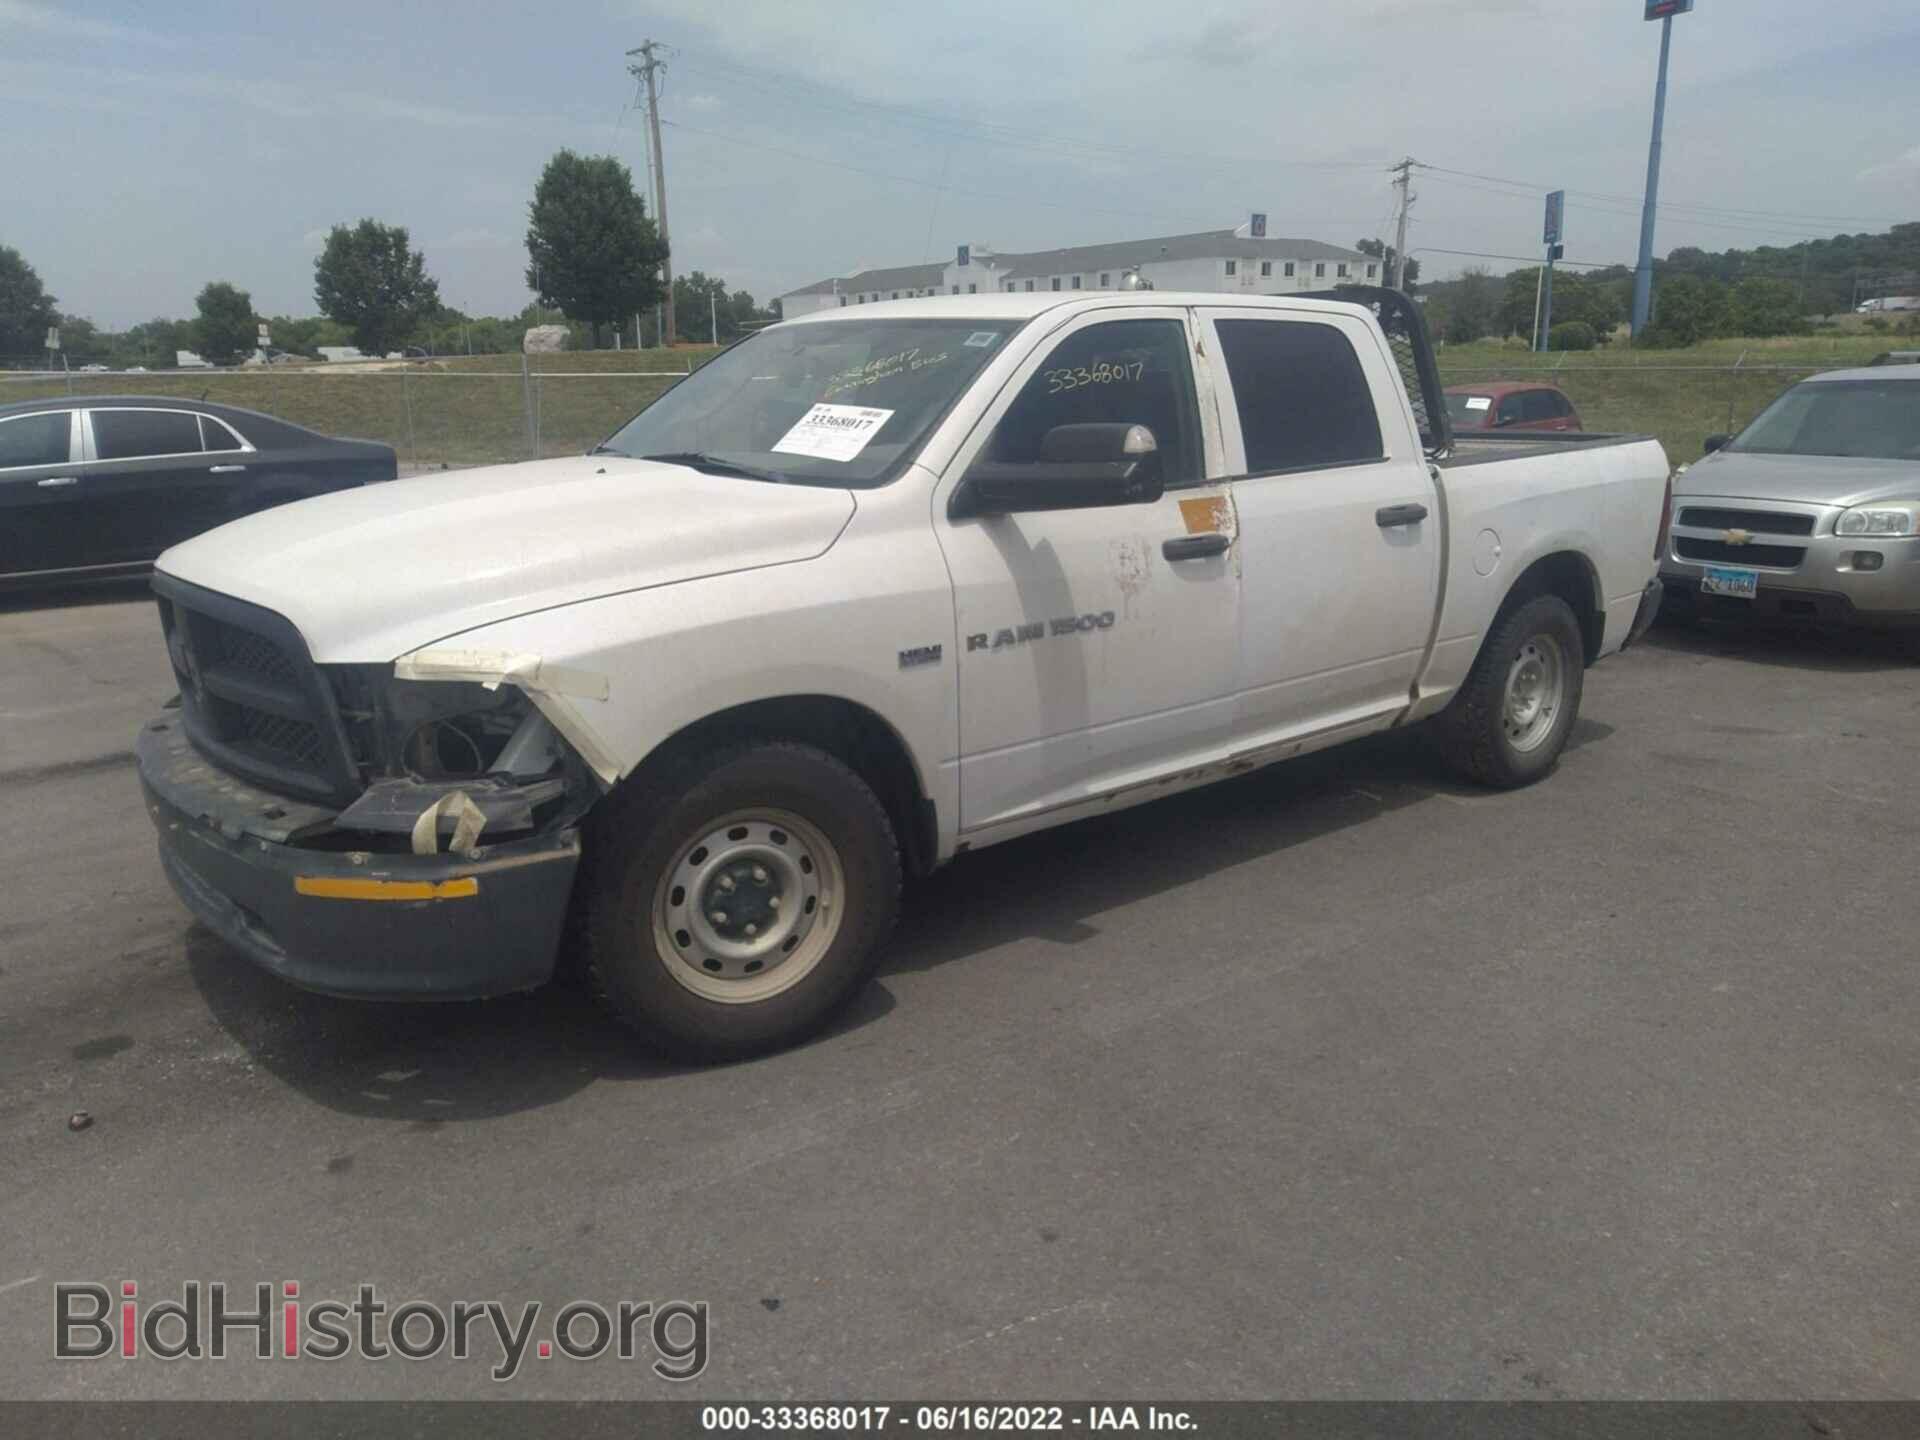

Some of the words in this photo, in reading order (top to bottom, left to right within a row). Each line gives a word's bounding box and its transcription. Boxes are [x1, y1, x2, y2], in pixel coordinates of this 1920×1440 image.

[1043, 361, 1144, 394] 33368017
[806, 414, 874, 431] 33368017
[966, 621, 1045, 652] RAM
[1049, 611, 1116, 637] 1500
